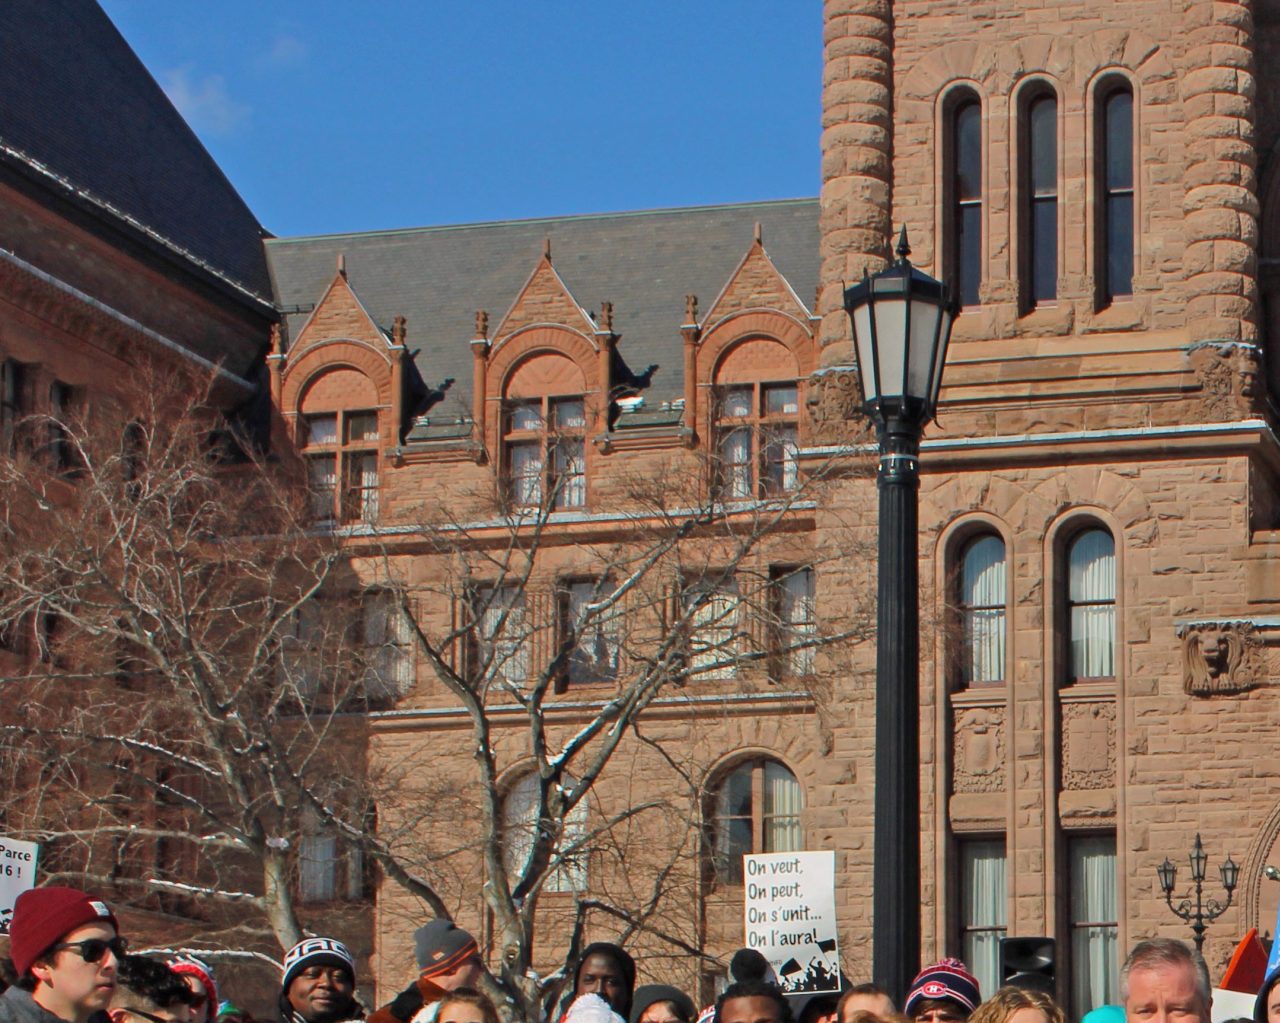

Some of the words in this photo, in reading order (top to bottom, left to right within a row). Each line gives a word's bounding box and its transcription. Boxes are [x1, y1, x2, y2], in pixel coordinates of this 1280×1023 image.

[747, 859, 767, 876] On
[748, 883, 767, 900] On
[748, 907, 767, 924] On
[748, 931, 767, 948] On
